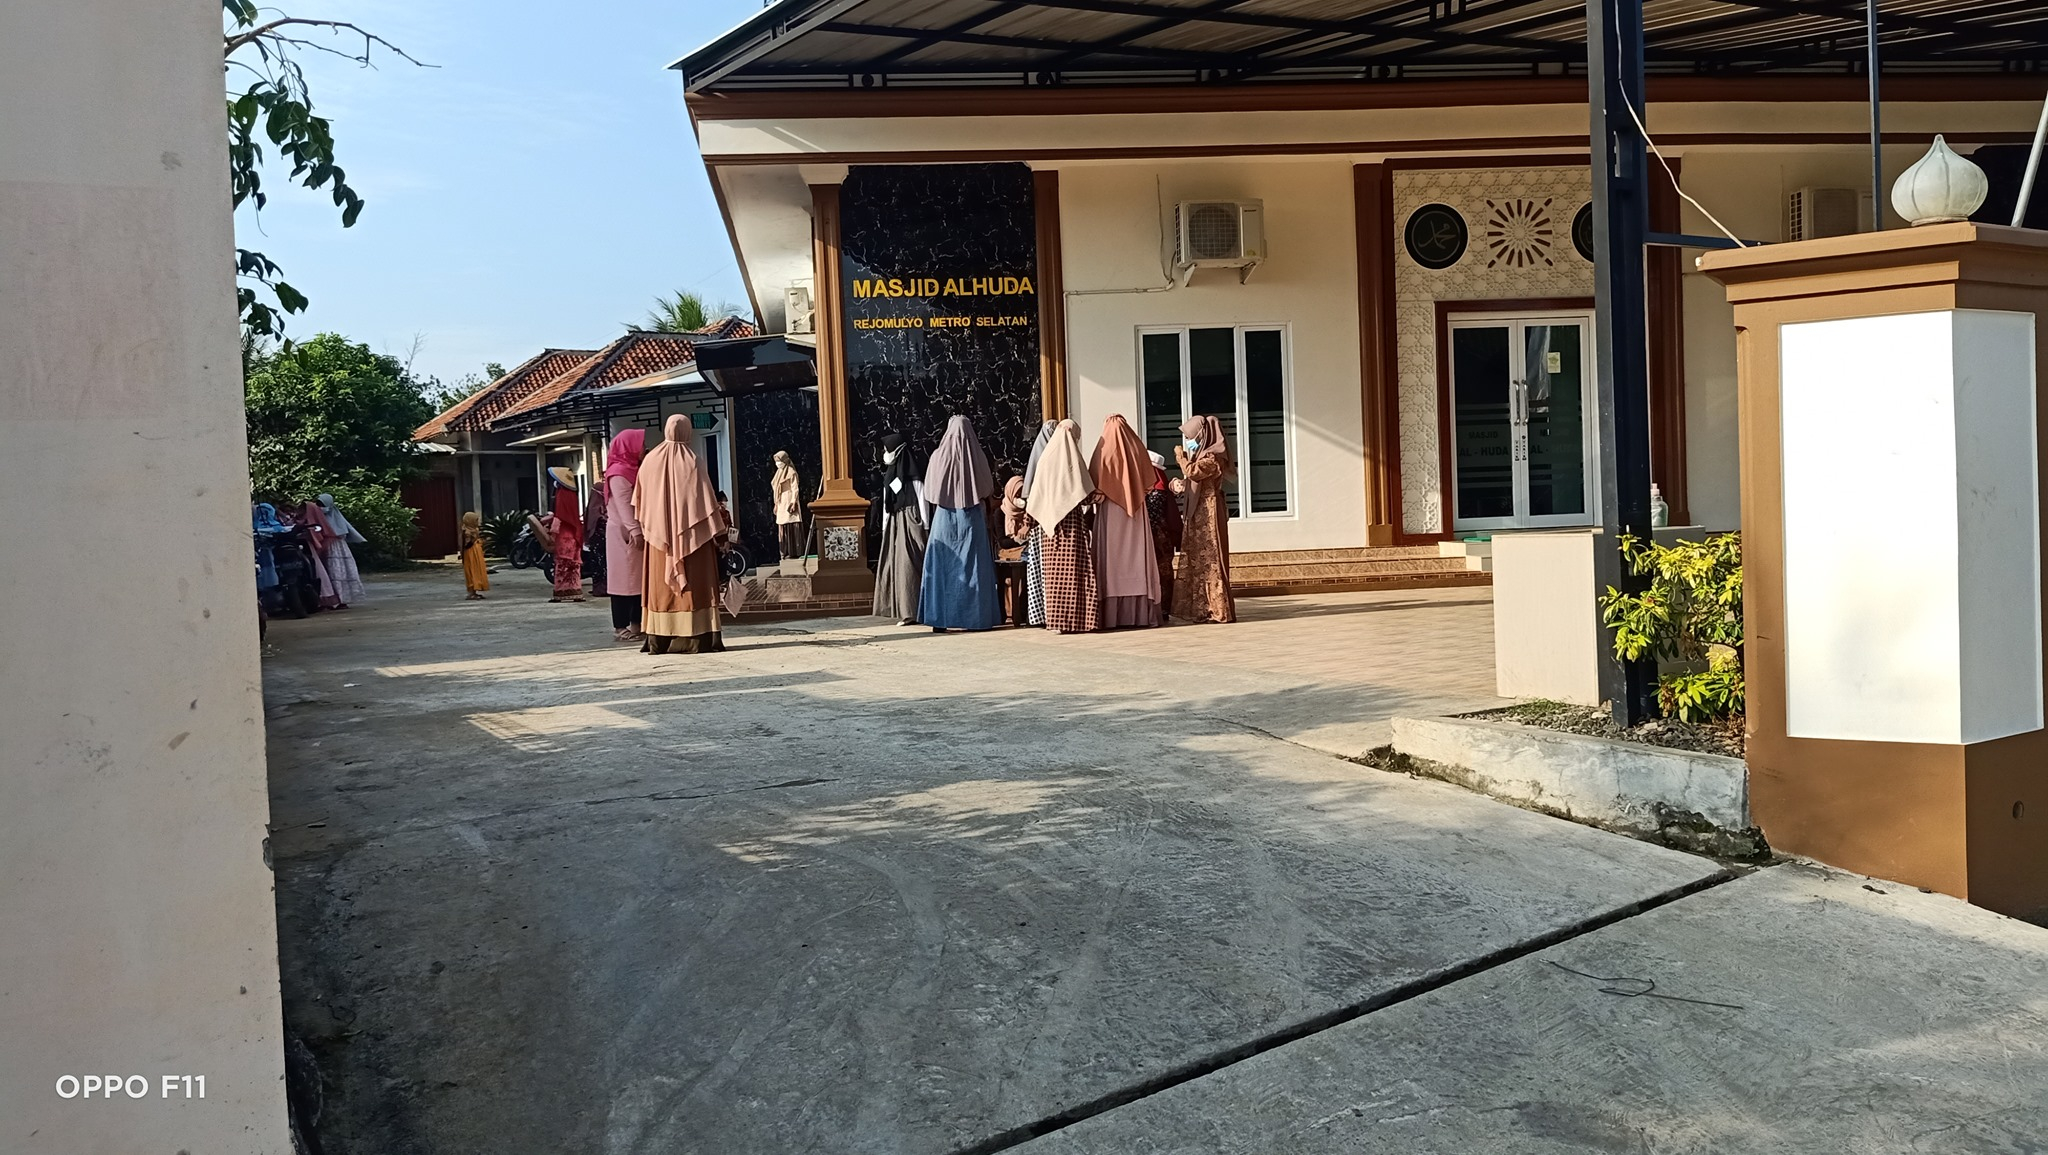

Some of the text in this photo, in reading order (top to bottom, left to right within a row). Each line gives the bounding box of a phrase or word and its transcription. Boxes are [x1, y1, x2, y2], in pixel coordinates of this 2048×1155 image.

[853, 276, 1034, 297] MASJID ALHUDA
[853, 316, 1028, 329] REJOMULYO METRO SELATAN
